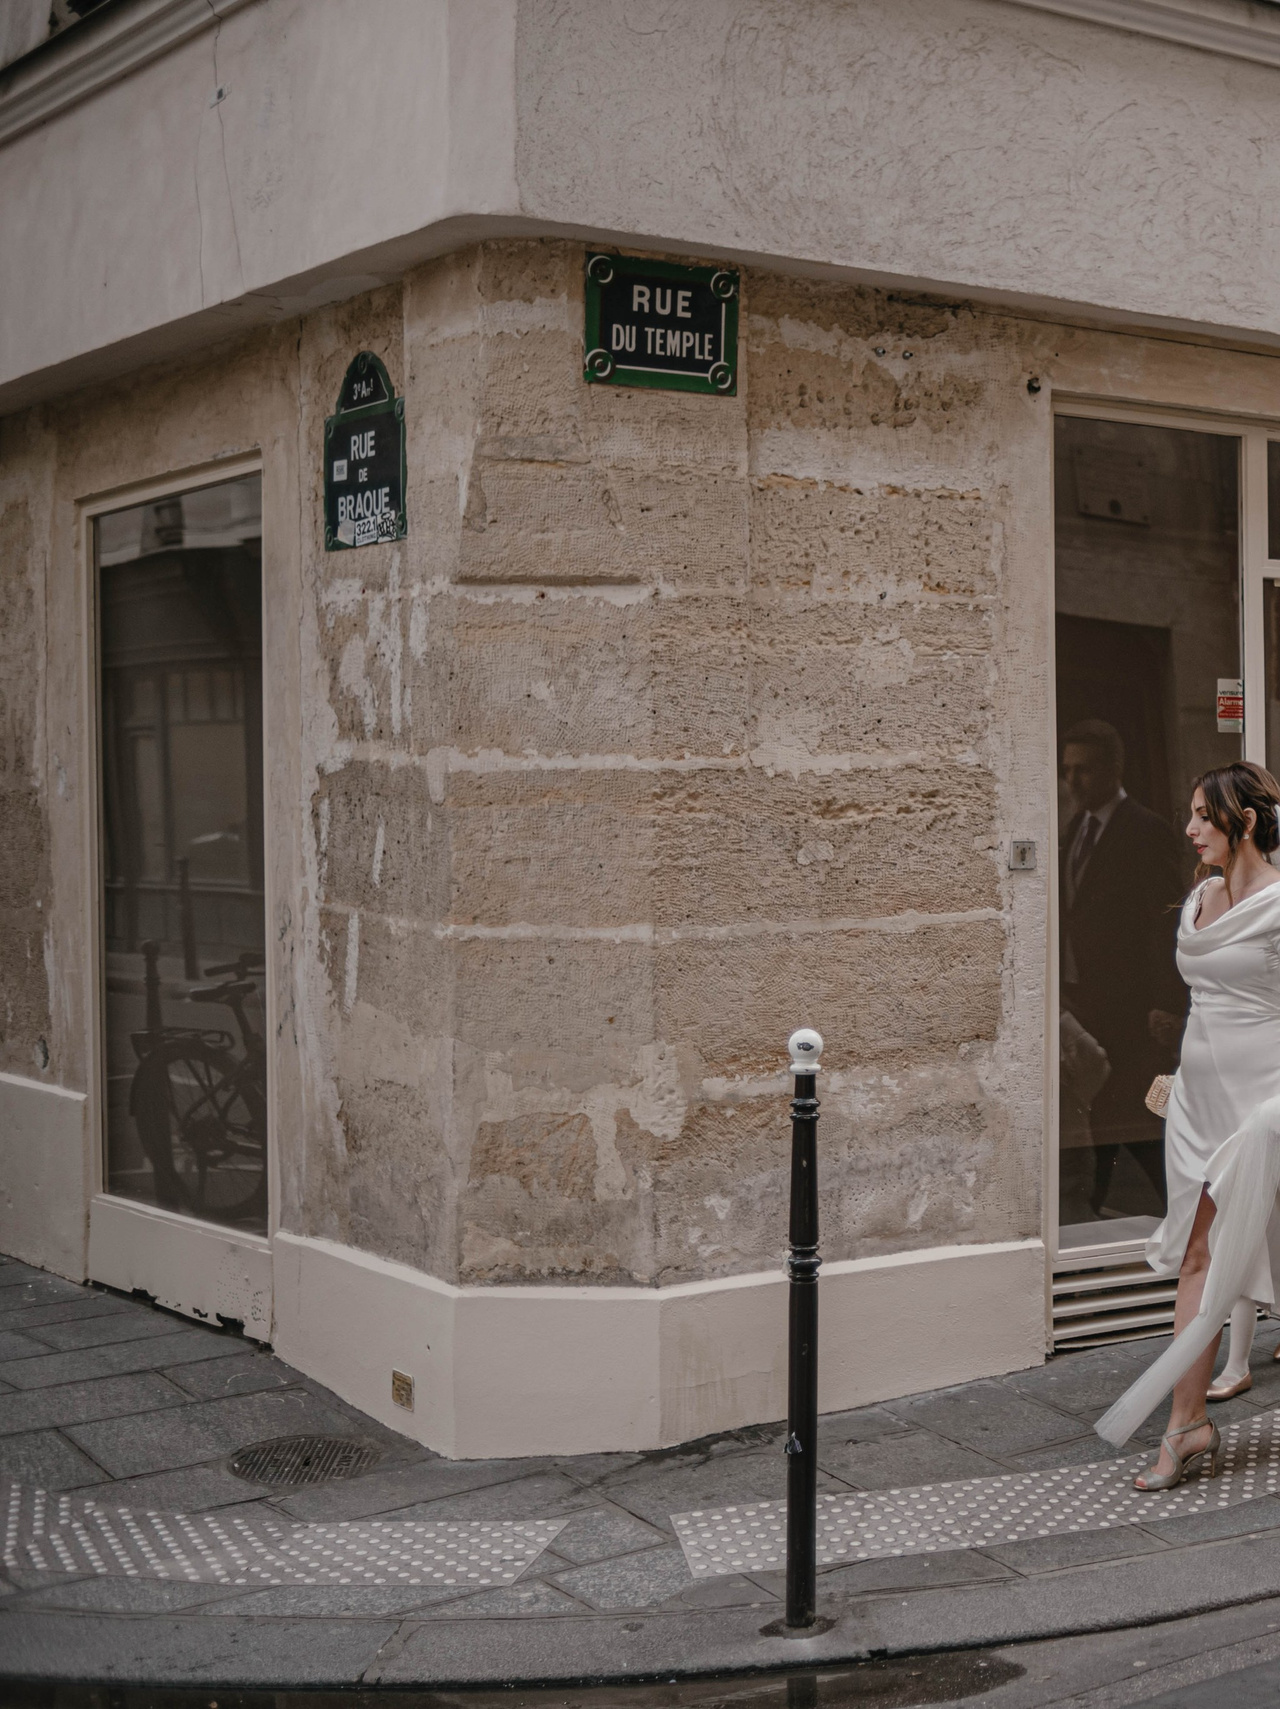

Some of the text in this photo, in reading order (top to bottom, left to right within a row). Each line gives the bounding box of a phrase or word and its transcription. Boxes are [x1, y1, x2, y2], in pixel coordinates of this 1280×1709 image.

[632, 284, 692, 318] RUE
[611, 323, 713, 361] DU TEMPLE
[350, 430, 376, 461] RUE
[358, 467, 368, 483] DE
[337, 486, 391, 522] BRAQUE
[356, 518, 376, 537] 322.1
